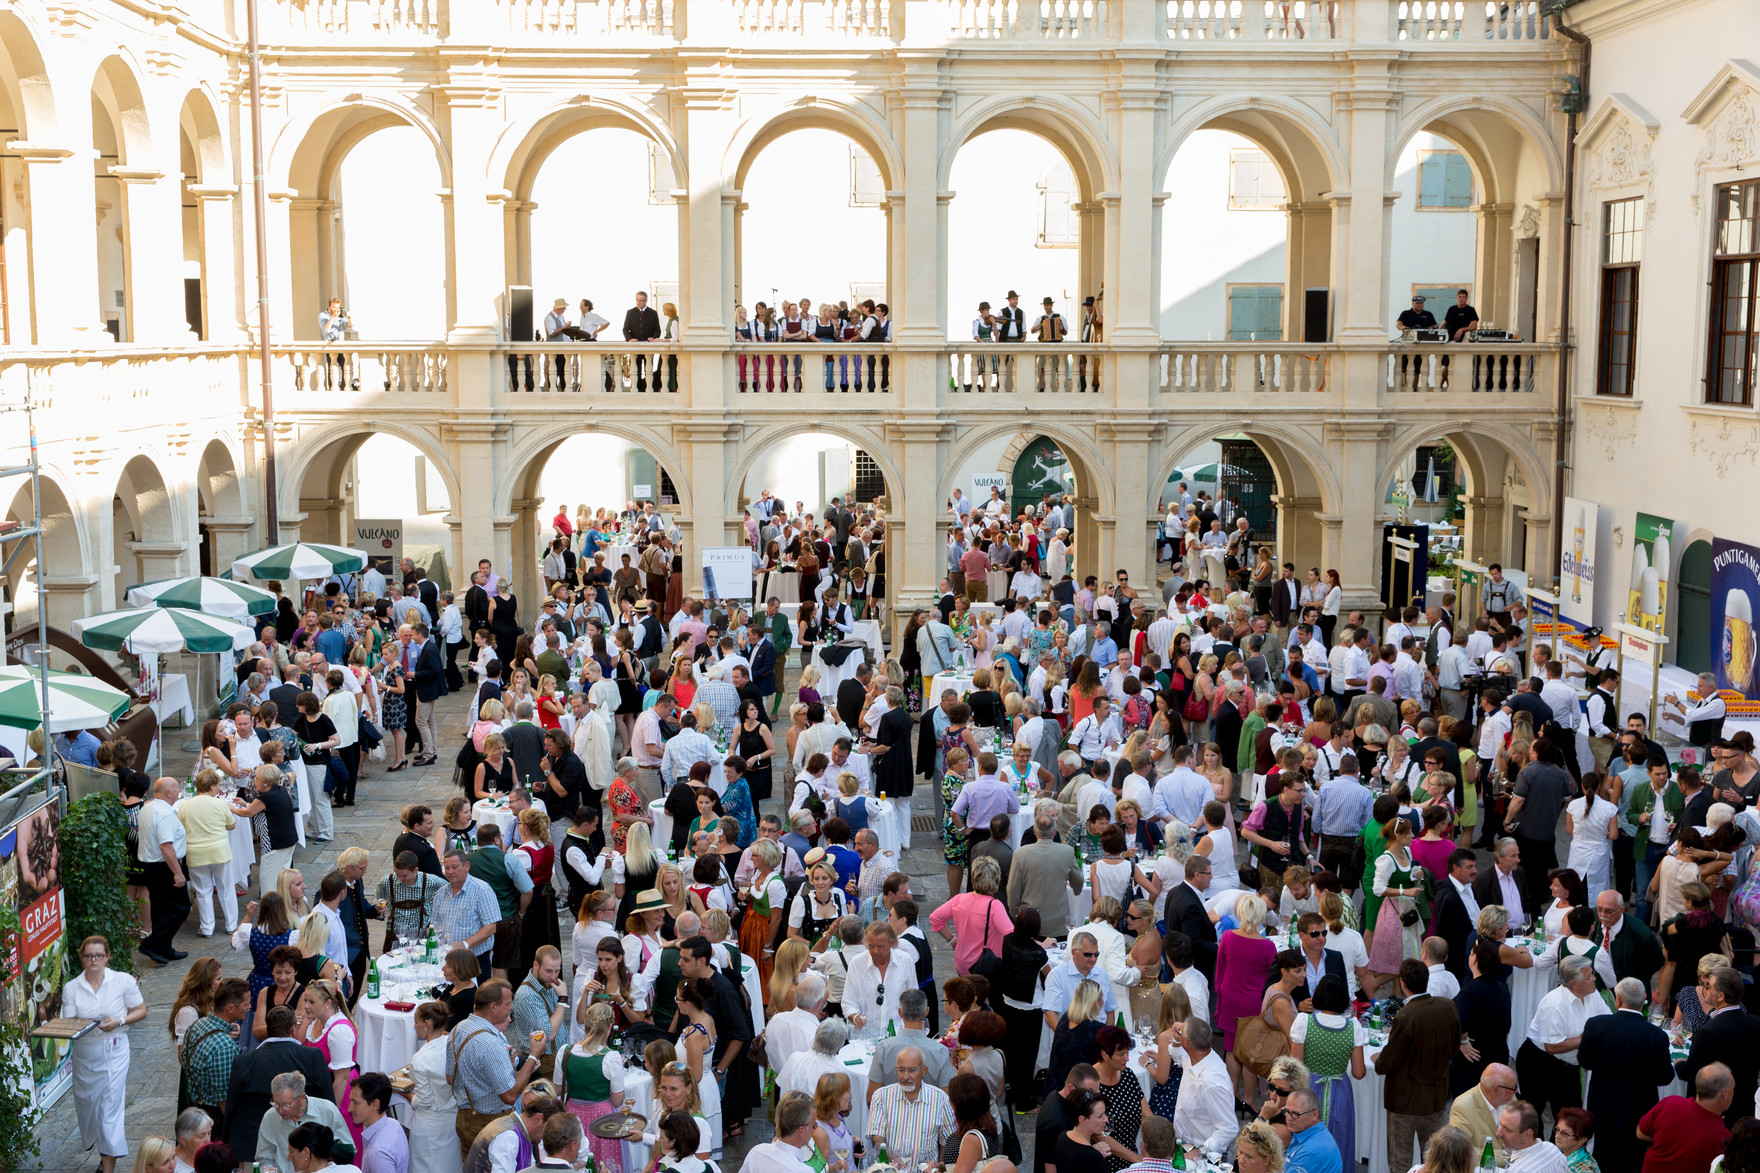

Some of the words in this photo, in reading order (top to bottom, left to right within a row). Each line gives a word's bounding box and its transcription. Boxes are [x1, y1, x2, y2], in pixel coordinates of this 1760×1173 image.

[973, 478, 1004, 487] VULCANO
[357, 527, 400, 540] VULCANO
[1562, 551, 1594, 582] Edelweiss
[25, 894, 58, 934] GRAZ
